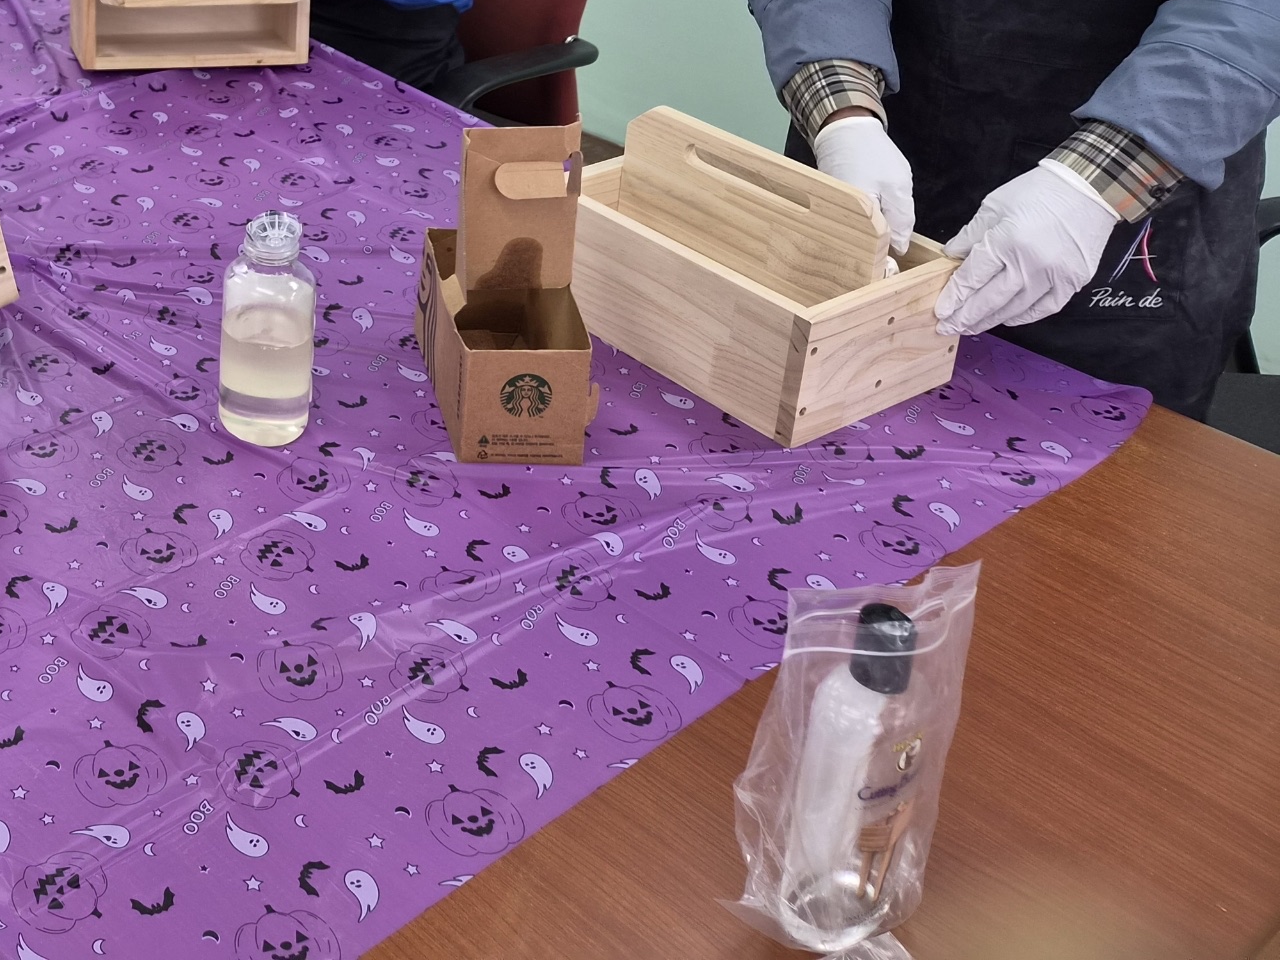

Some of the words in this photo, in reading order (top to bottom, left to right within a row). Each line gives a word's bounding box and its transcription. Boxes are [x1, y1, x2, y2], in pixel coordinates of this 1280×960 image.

[1088, 286, 1135, 309] Pain
[1138, 287, 1164, 309] de
[369, 354, 388, 372] BOO
[90, 467, 114, 488] BOO
[793, 464, 811, 485] BOO
[370, 500, 392, 523] BOO
[662, 518, 686, 549] BOO
[215, 574, 241, 598] BOO
[38, 656, 68, 684] BOO
[183, 799, 215, 835] BOO
